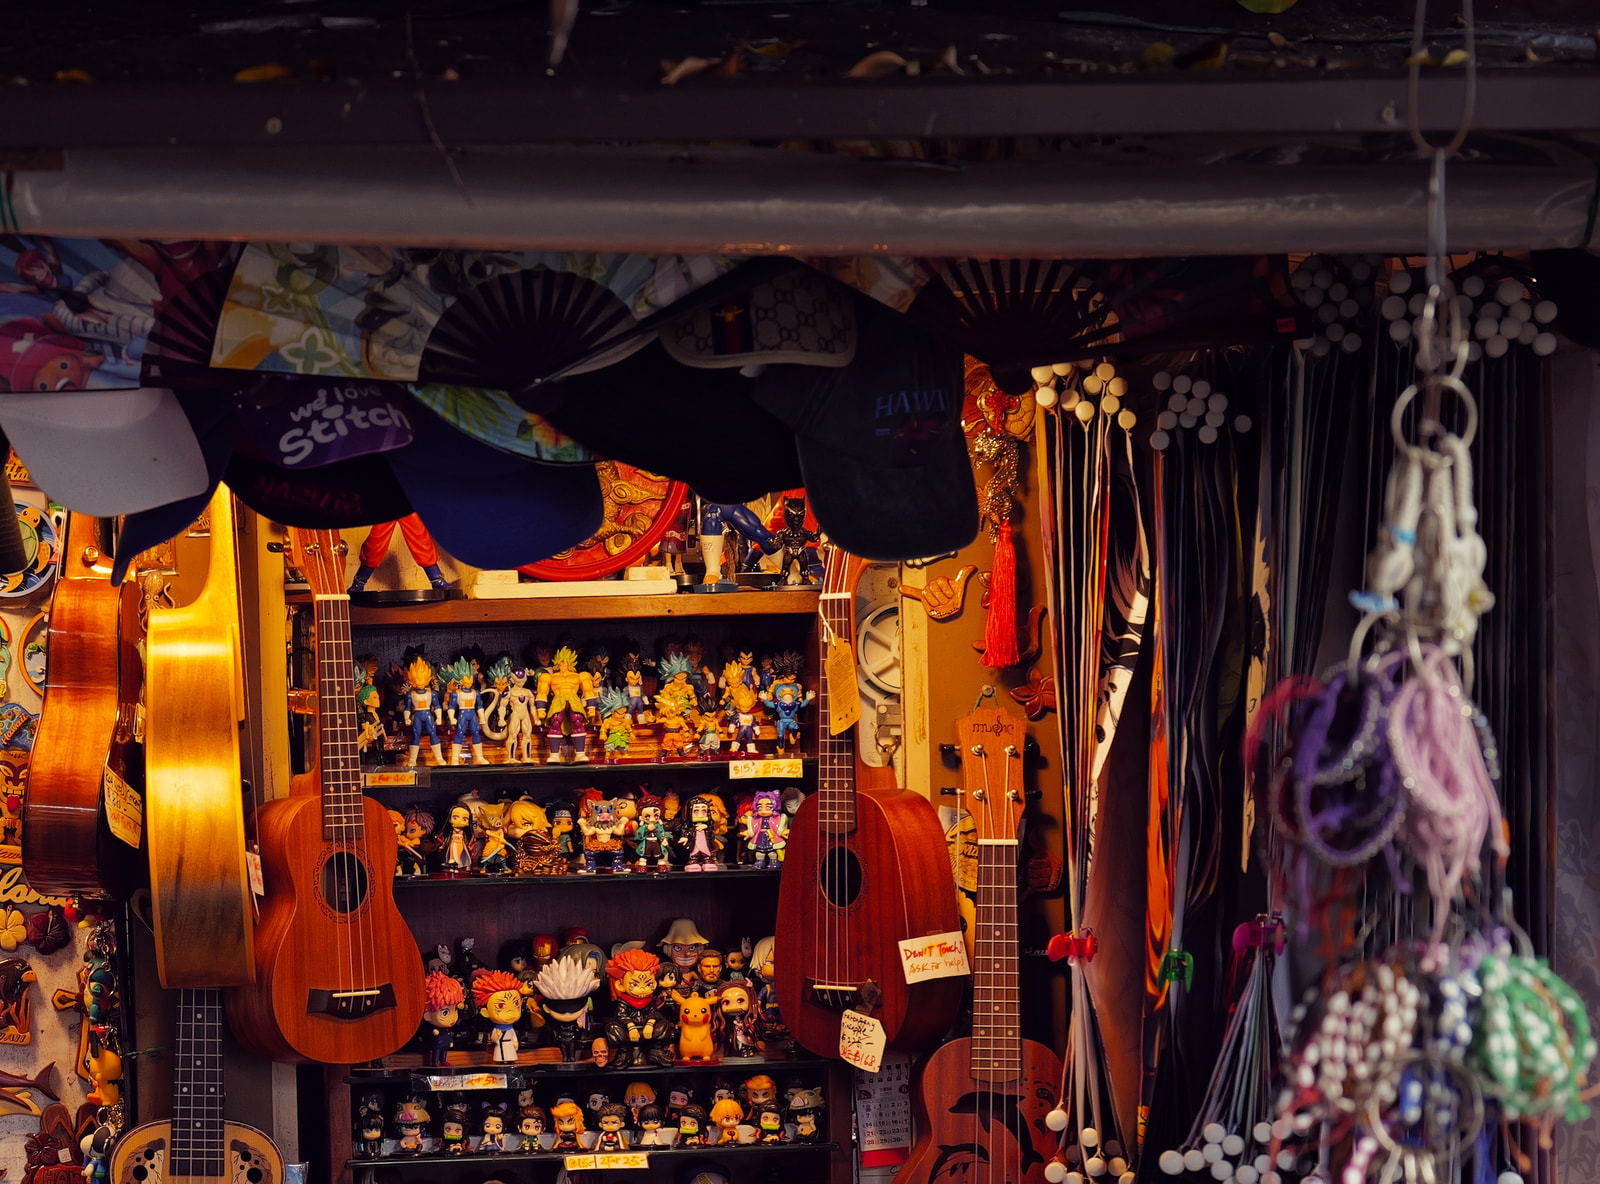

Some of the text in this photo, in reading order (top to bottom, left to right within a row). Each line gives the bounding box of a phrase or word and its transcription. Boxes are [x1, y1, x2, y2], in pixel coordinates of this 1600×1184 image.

[290, 385, 383, 422] we love
[278, 402, 412, 465] Stitch
